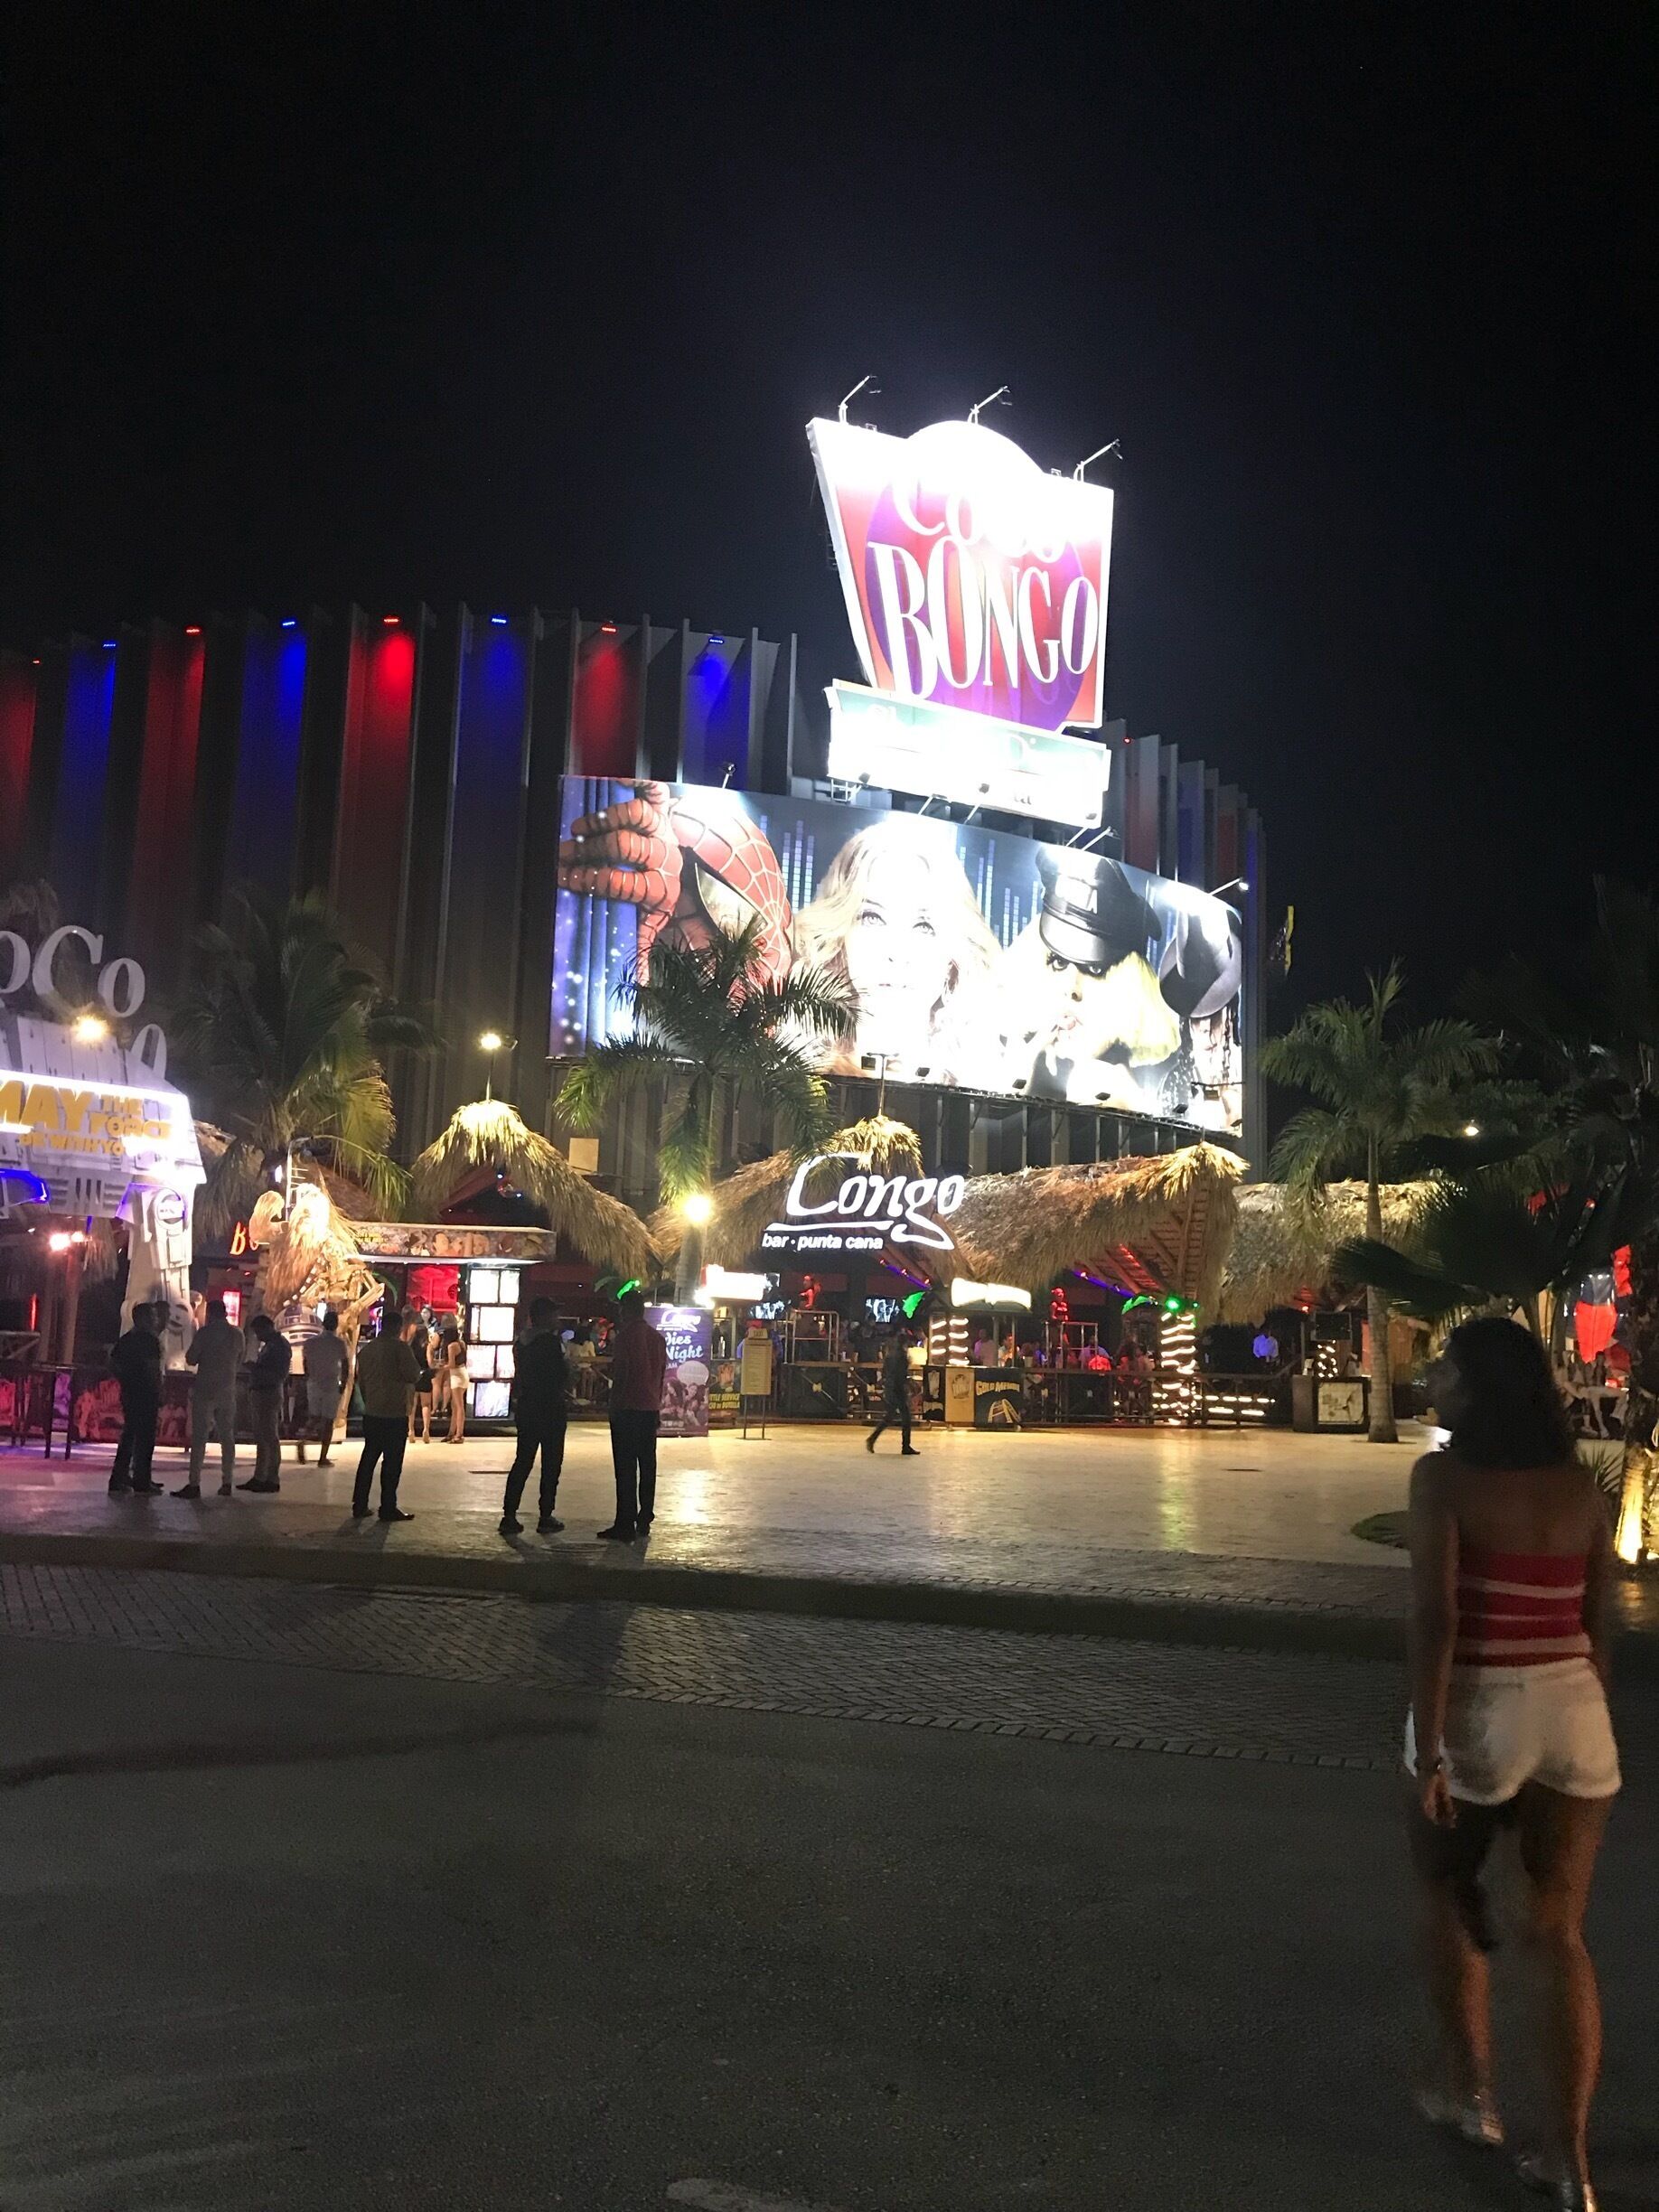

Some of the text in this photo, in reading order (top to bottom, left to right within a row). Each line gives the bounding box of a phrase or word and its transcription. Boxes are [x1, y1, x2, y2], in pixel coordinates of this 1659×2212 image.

[890, 479, 1067, 565] CO
[867, 535, 1098, 700] BONGO
[99, 1093, 144, 1116] THE
[50, 1134, 99, 1153] WITH
[100, 1139, 127, 1157] YO
[785, 1153, 965, 1251] Congo
[762, 1233, 884, 1251] bar punta cana
[665, 1345, 704, 1364] Night
